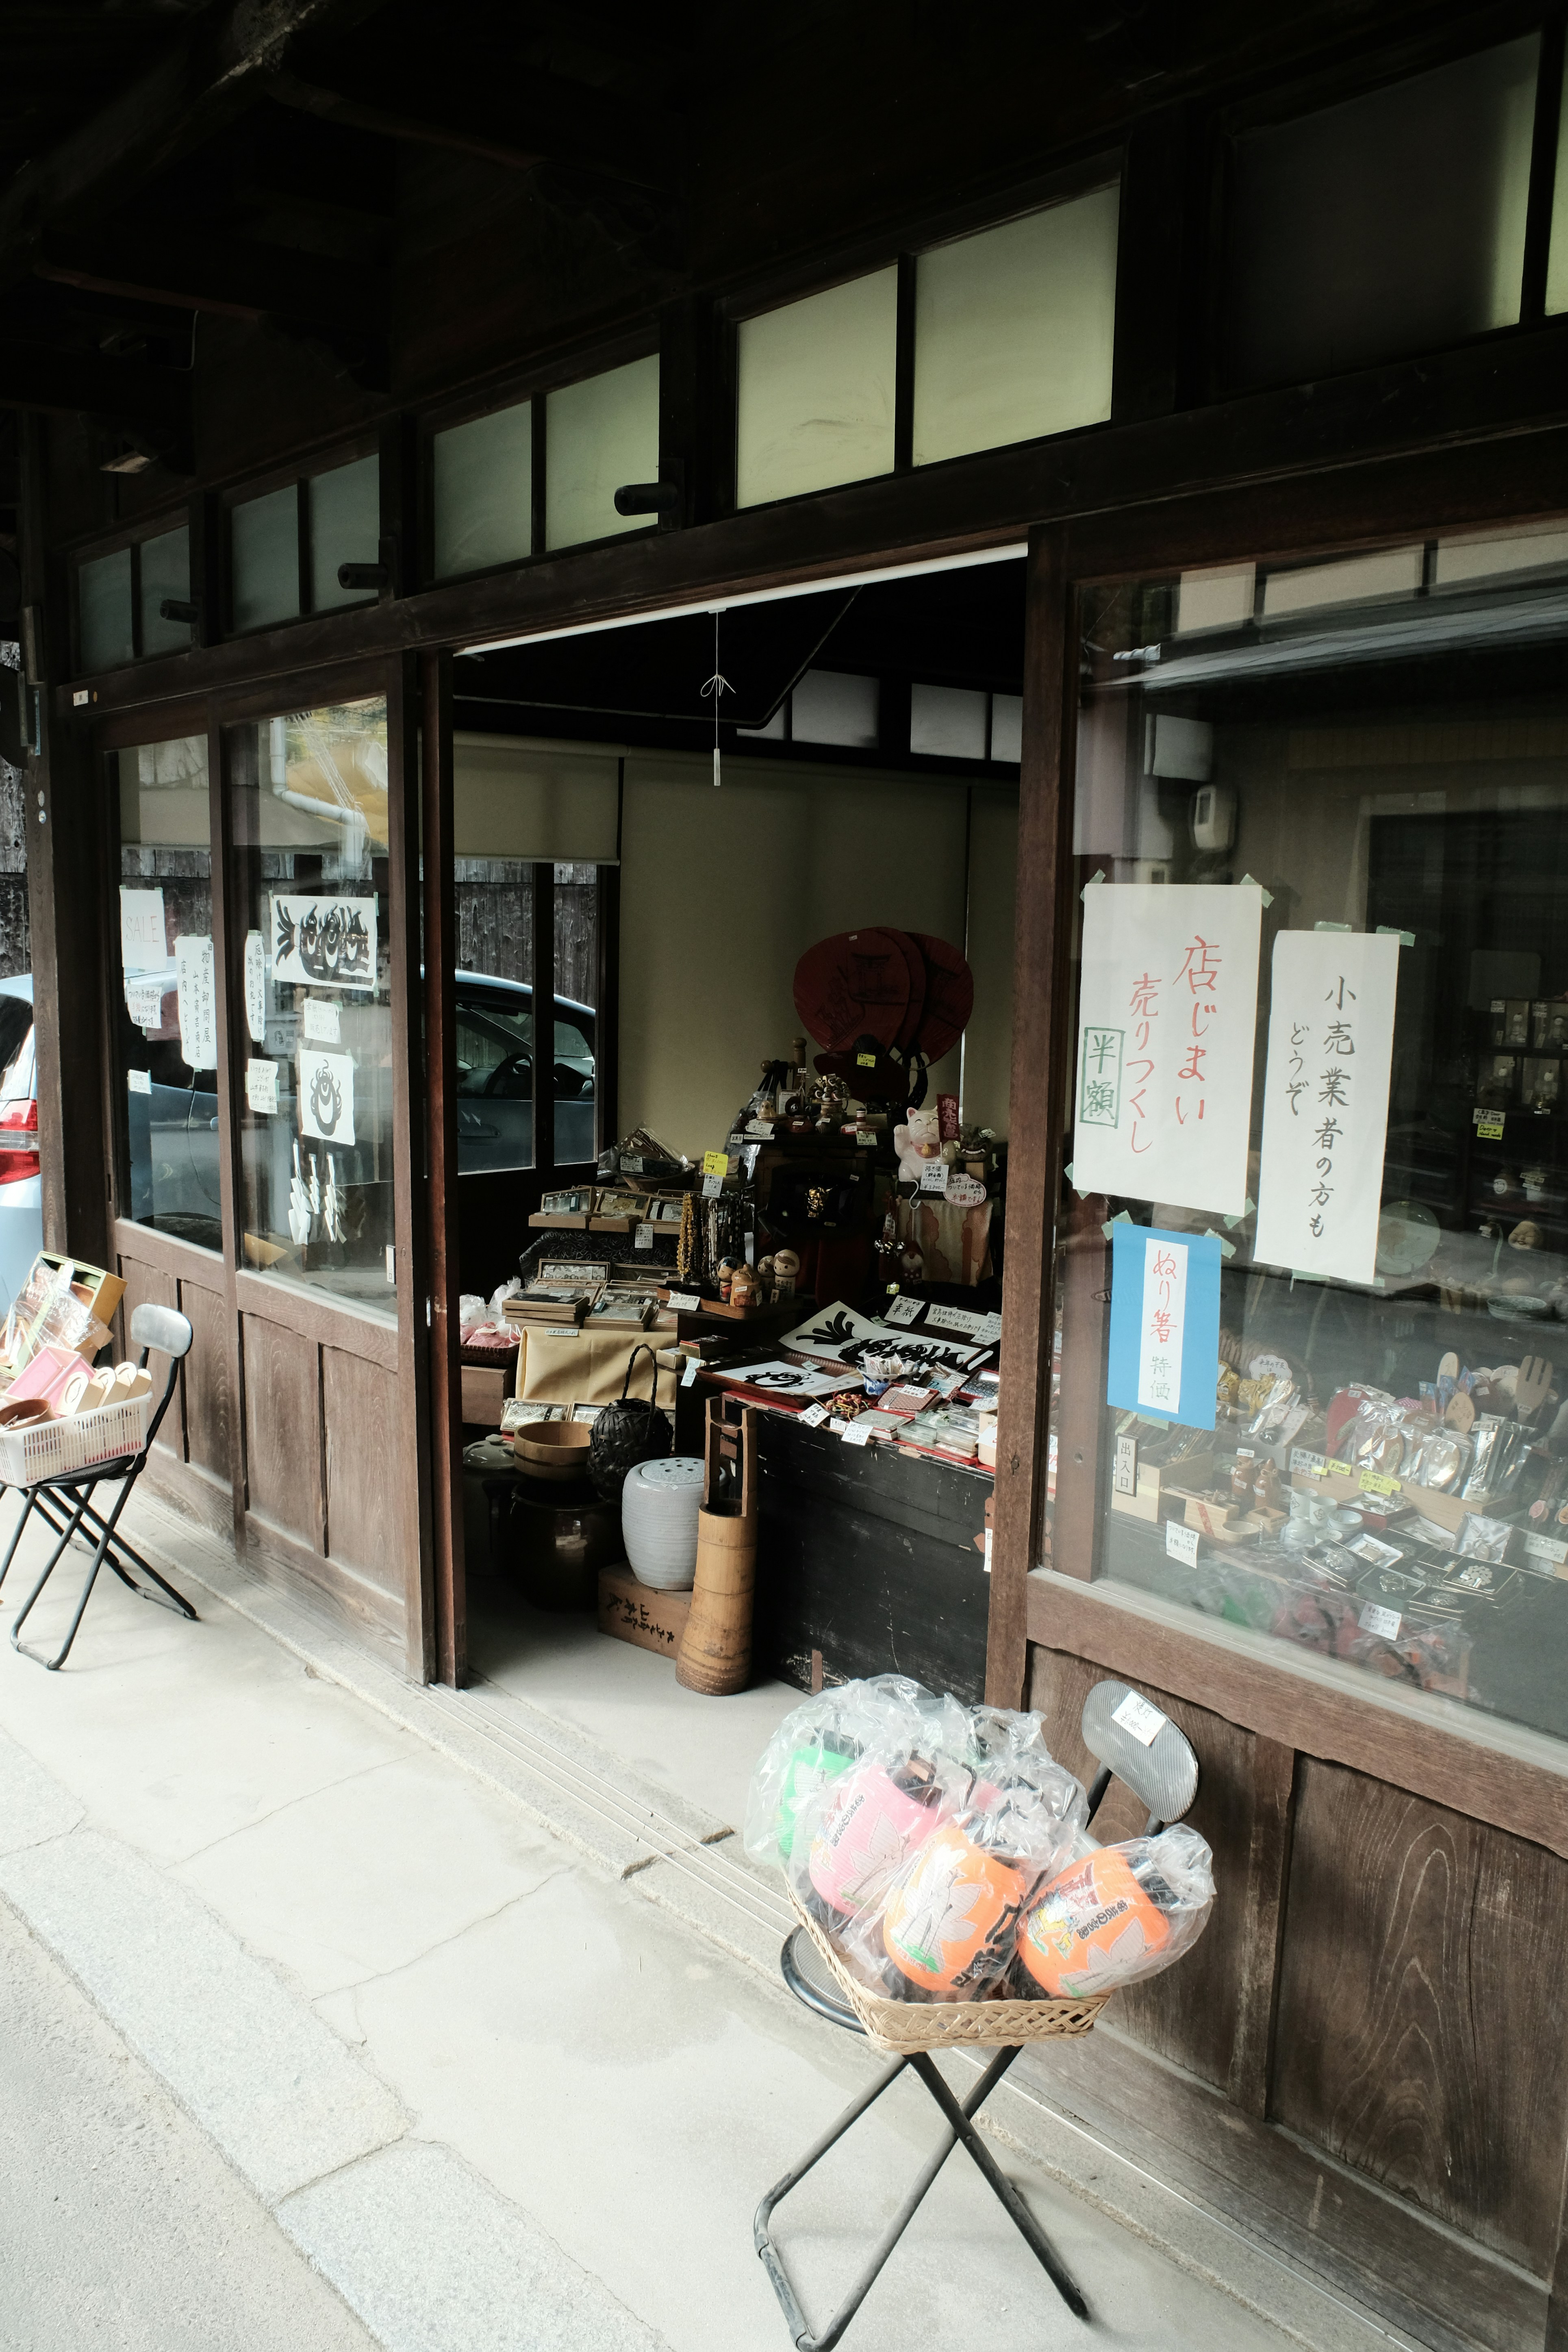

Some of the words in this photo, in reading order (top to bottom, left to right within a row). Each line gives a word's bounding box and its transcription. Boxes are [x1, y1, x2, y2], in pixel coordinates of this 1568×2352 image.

[126, 916, 159, 943] SALE
[1126, 973, 1162, 1153] 売りつくし
[1173, 935, 1222, 1125] 店じまい
[1286, 1022, 1310, 1116] どうぞ
[1086, 1034, 1116, 1120] 半額
[1308, 976, 1357, 1238] 小売業者の方も
[1151, 1250, 1177, 1343] ぬり箸
[1150, 1356, 1172, 1400] 特価
[1121, 1442, 1131, 1488] 出入口
